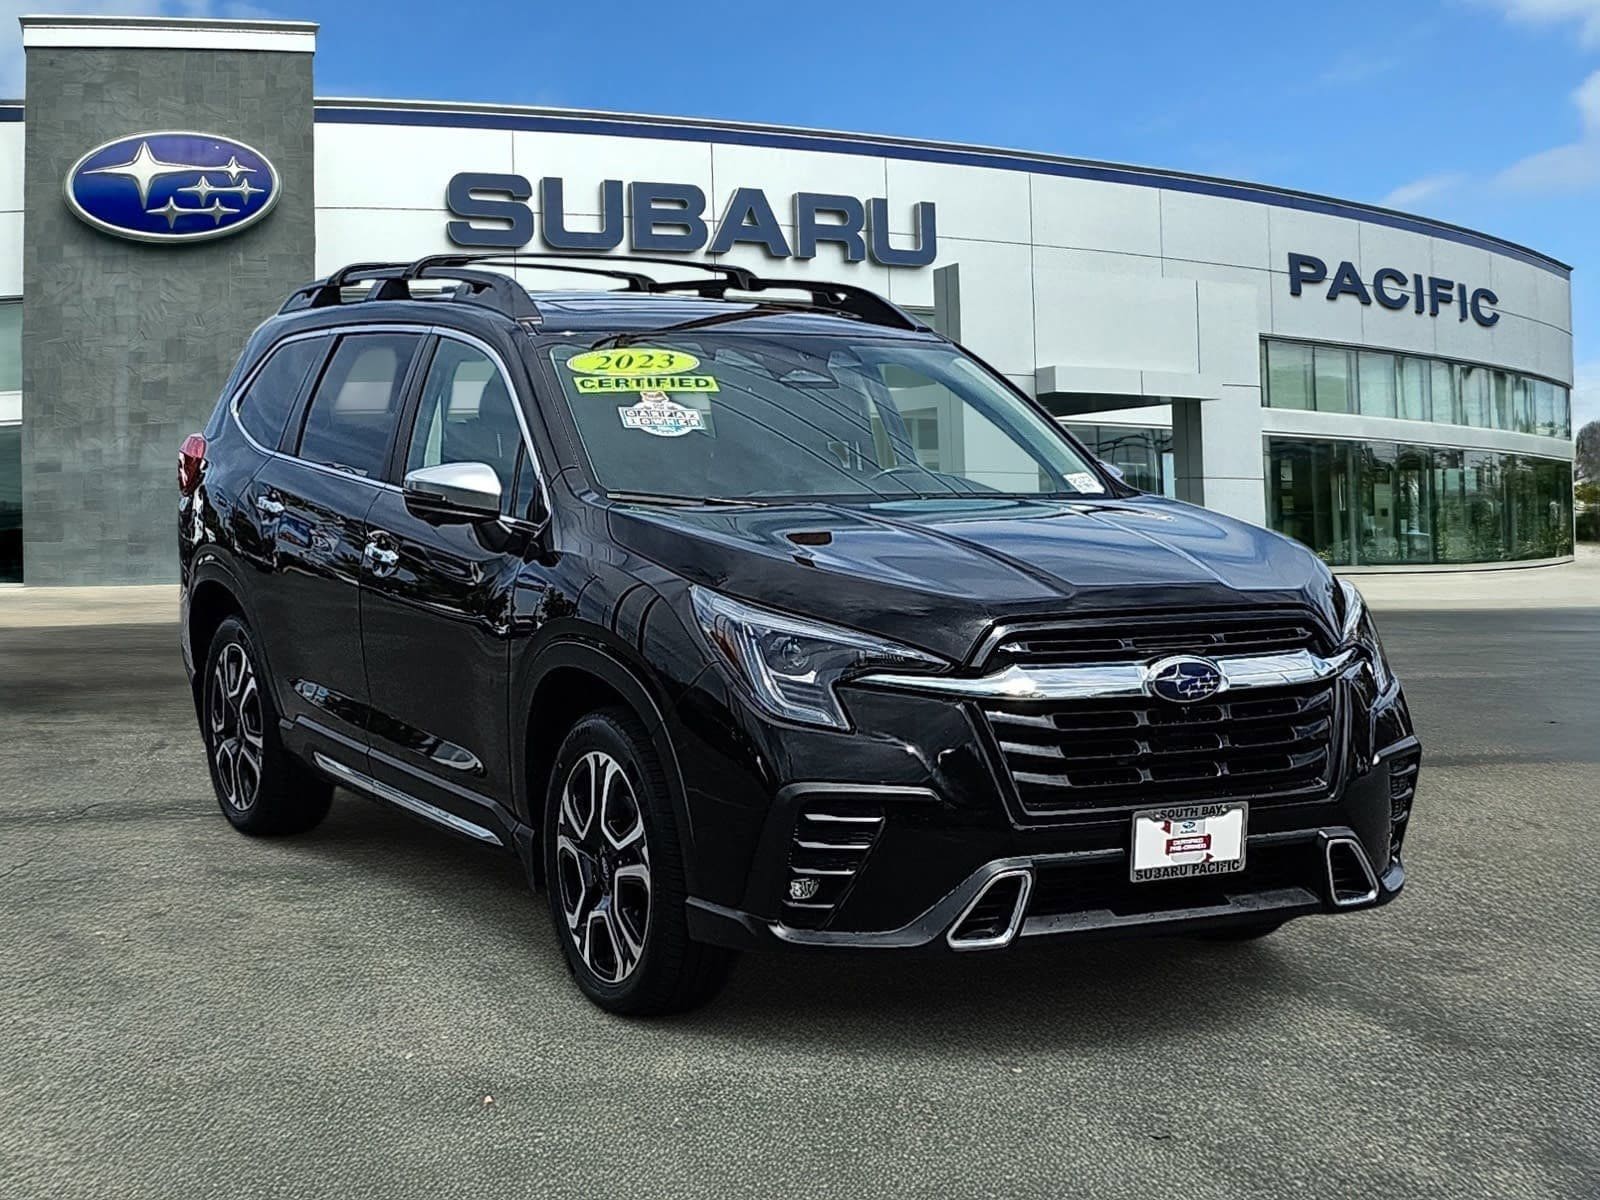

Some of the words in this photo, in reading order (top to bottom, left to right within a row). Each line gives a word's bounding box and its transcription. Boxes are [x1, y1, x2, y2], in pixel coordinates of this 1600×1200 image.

[447, 172, 937, 268] SUBARU
[1288, 252, 1500, 328] PACIFIC
[595, 353, 675, 370] 2023
[579, 378, 711, 388] CERTIFIED
[1160, 807, 1199, 819] SOUTH
[1201, 805, 1223, 815] BAY
[1135, 864, 1188, 880] SUBARU
[1191, 860, 1241, 875] PACIFIC
